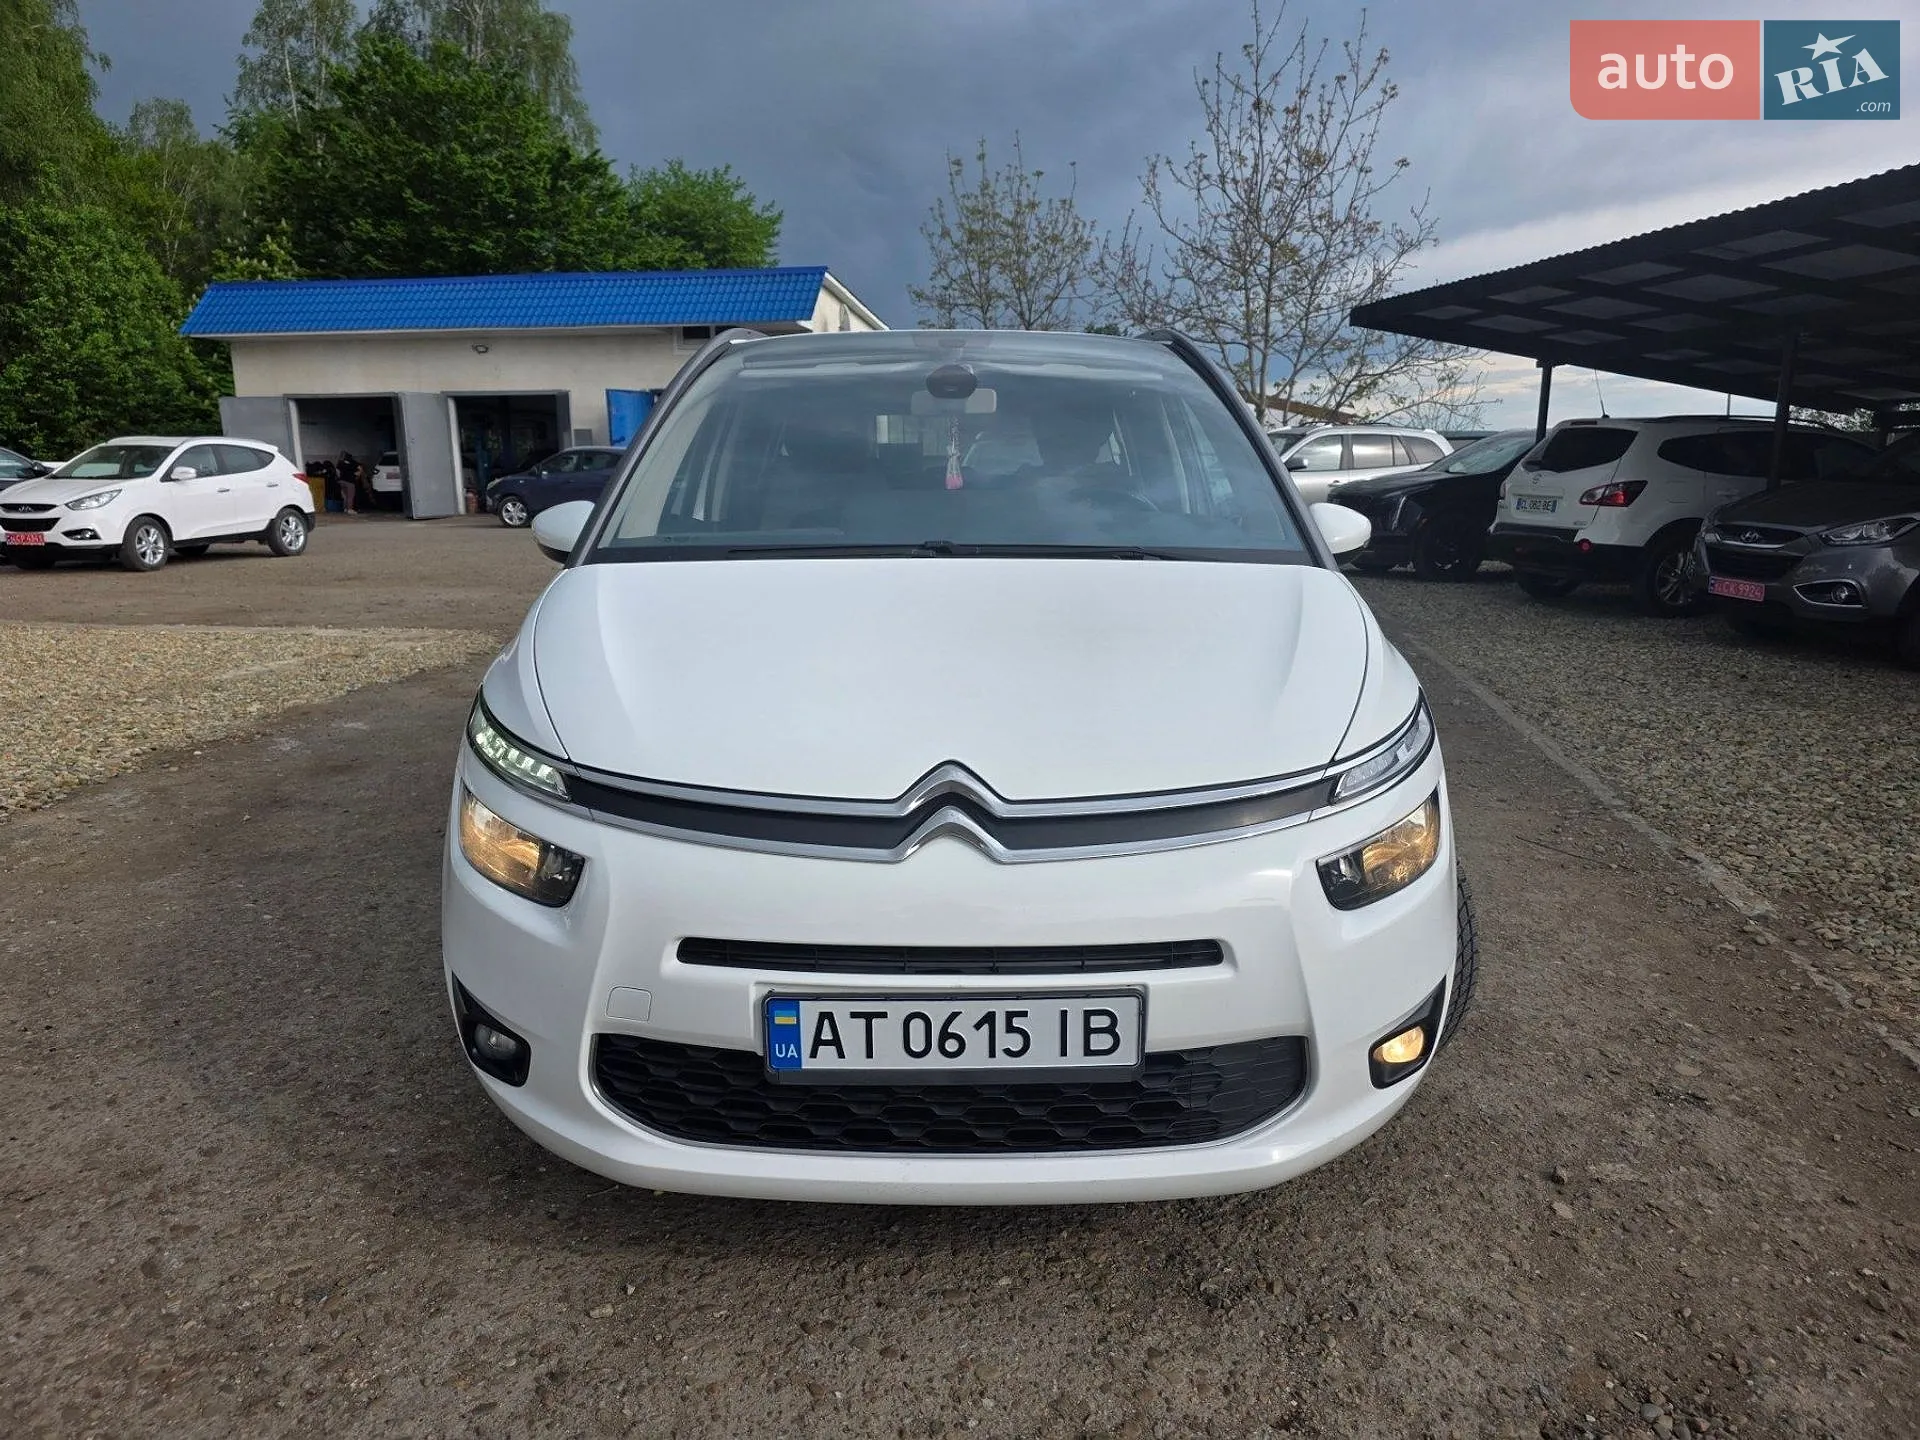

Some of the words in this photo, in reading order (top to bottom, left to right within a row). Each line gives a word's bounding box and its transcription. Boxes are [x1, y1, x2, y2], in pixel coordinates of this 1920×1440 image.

[809, 1011, 888, 1060] AT
[903, 1010, 1031, 1060] 0615
[1060, 1008, 1121, 1057] IB
[775, 1043, 798, 1060] UA
